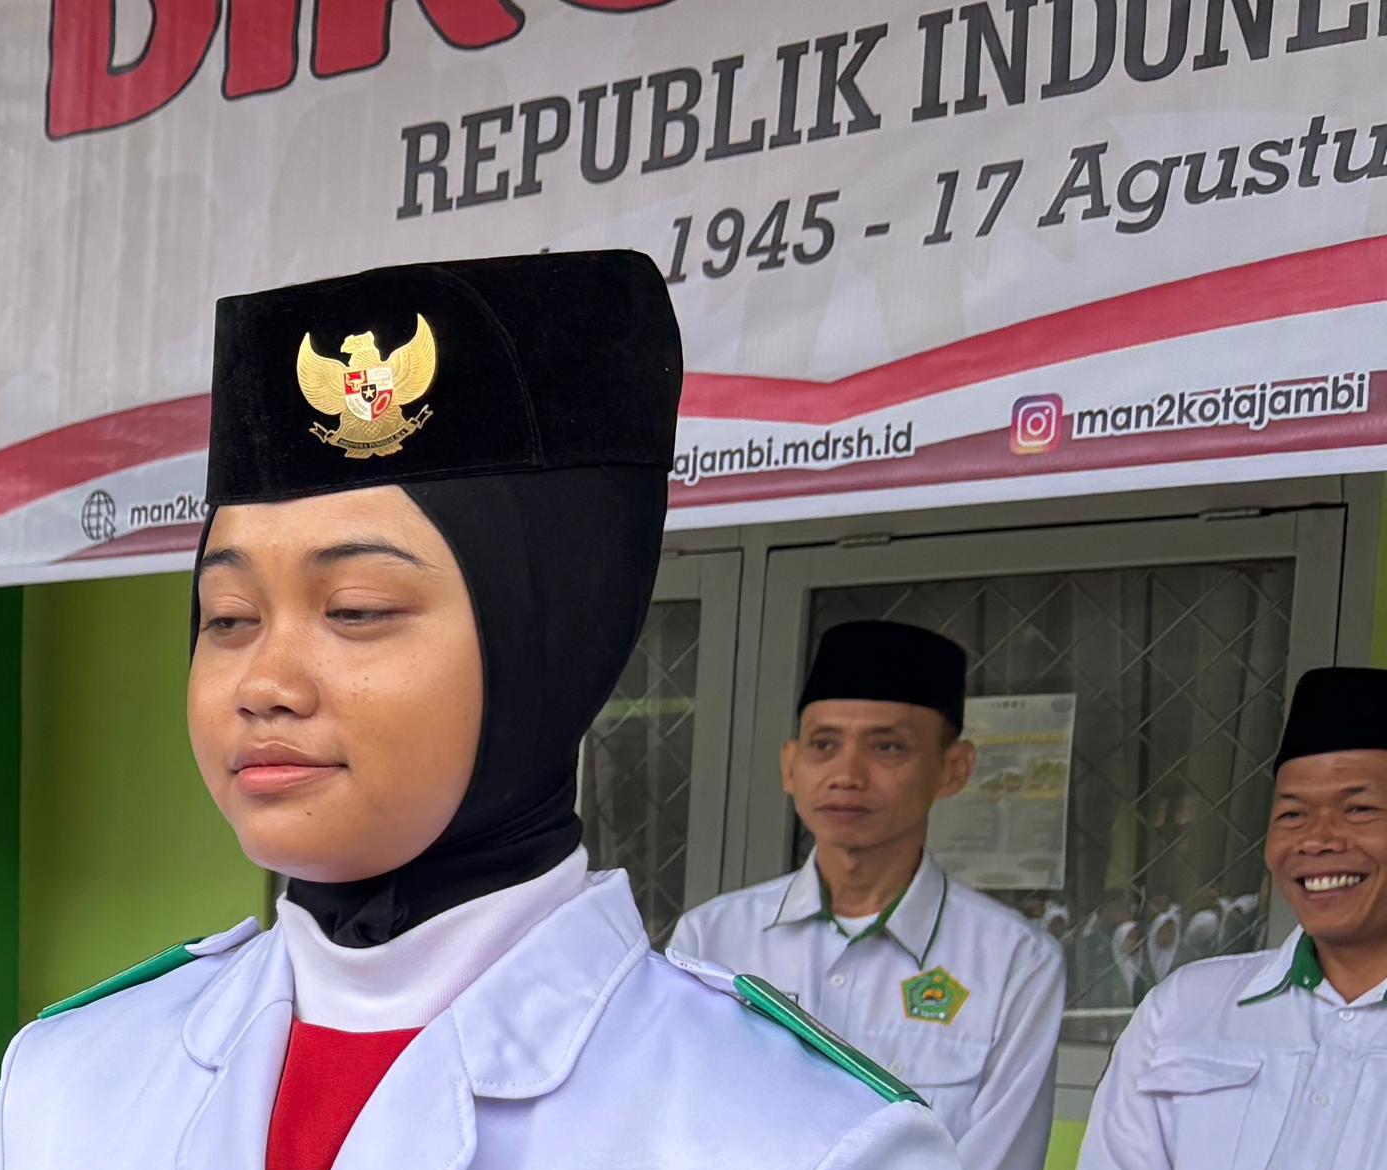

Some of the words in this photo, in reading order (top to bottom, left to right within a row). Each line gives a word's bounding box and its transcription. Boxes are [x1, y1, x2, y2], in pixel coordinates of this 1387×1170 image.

[395, 24, 891, 220] REPUBLIK
[665, 190, 840, 285] 1945
[923, 162, 1021, 246] 17
[1075, 373, 1367, 434] man2kotajambi
